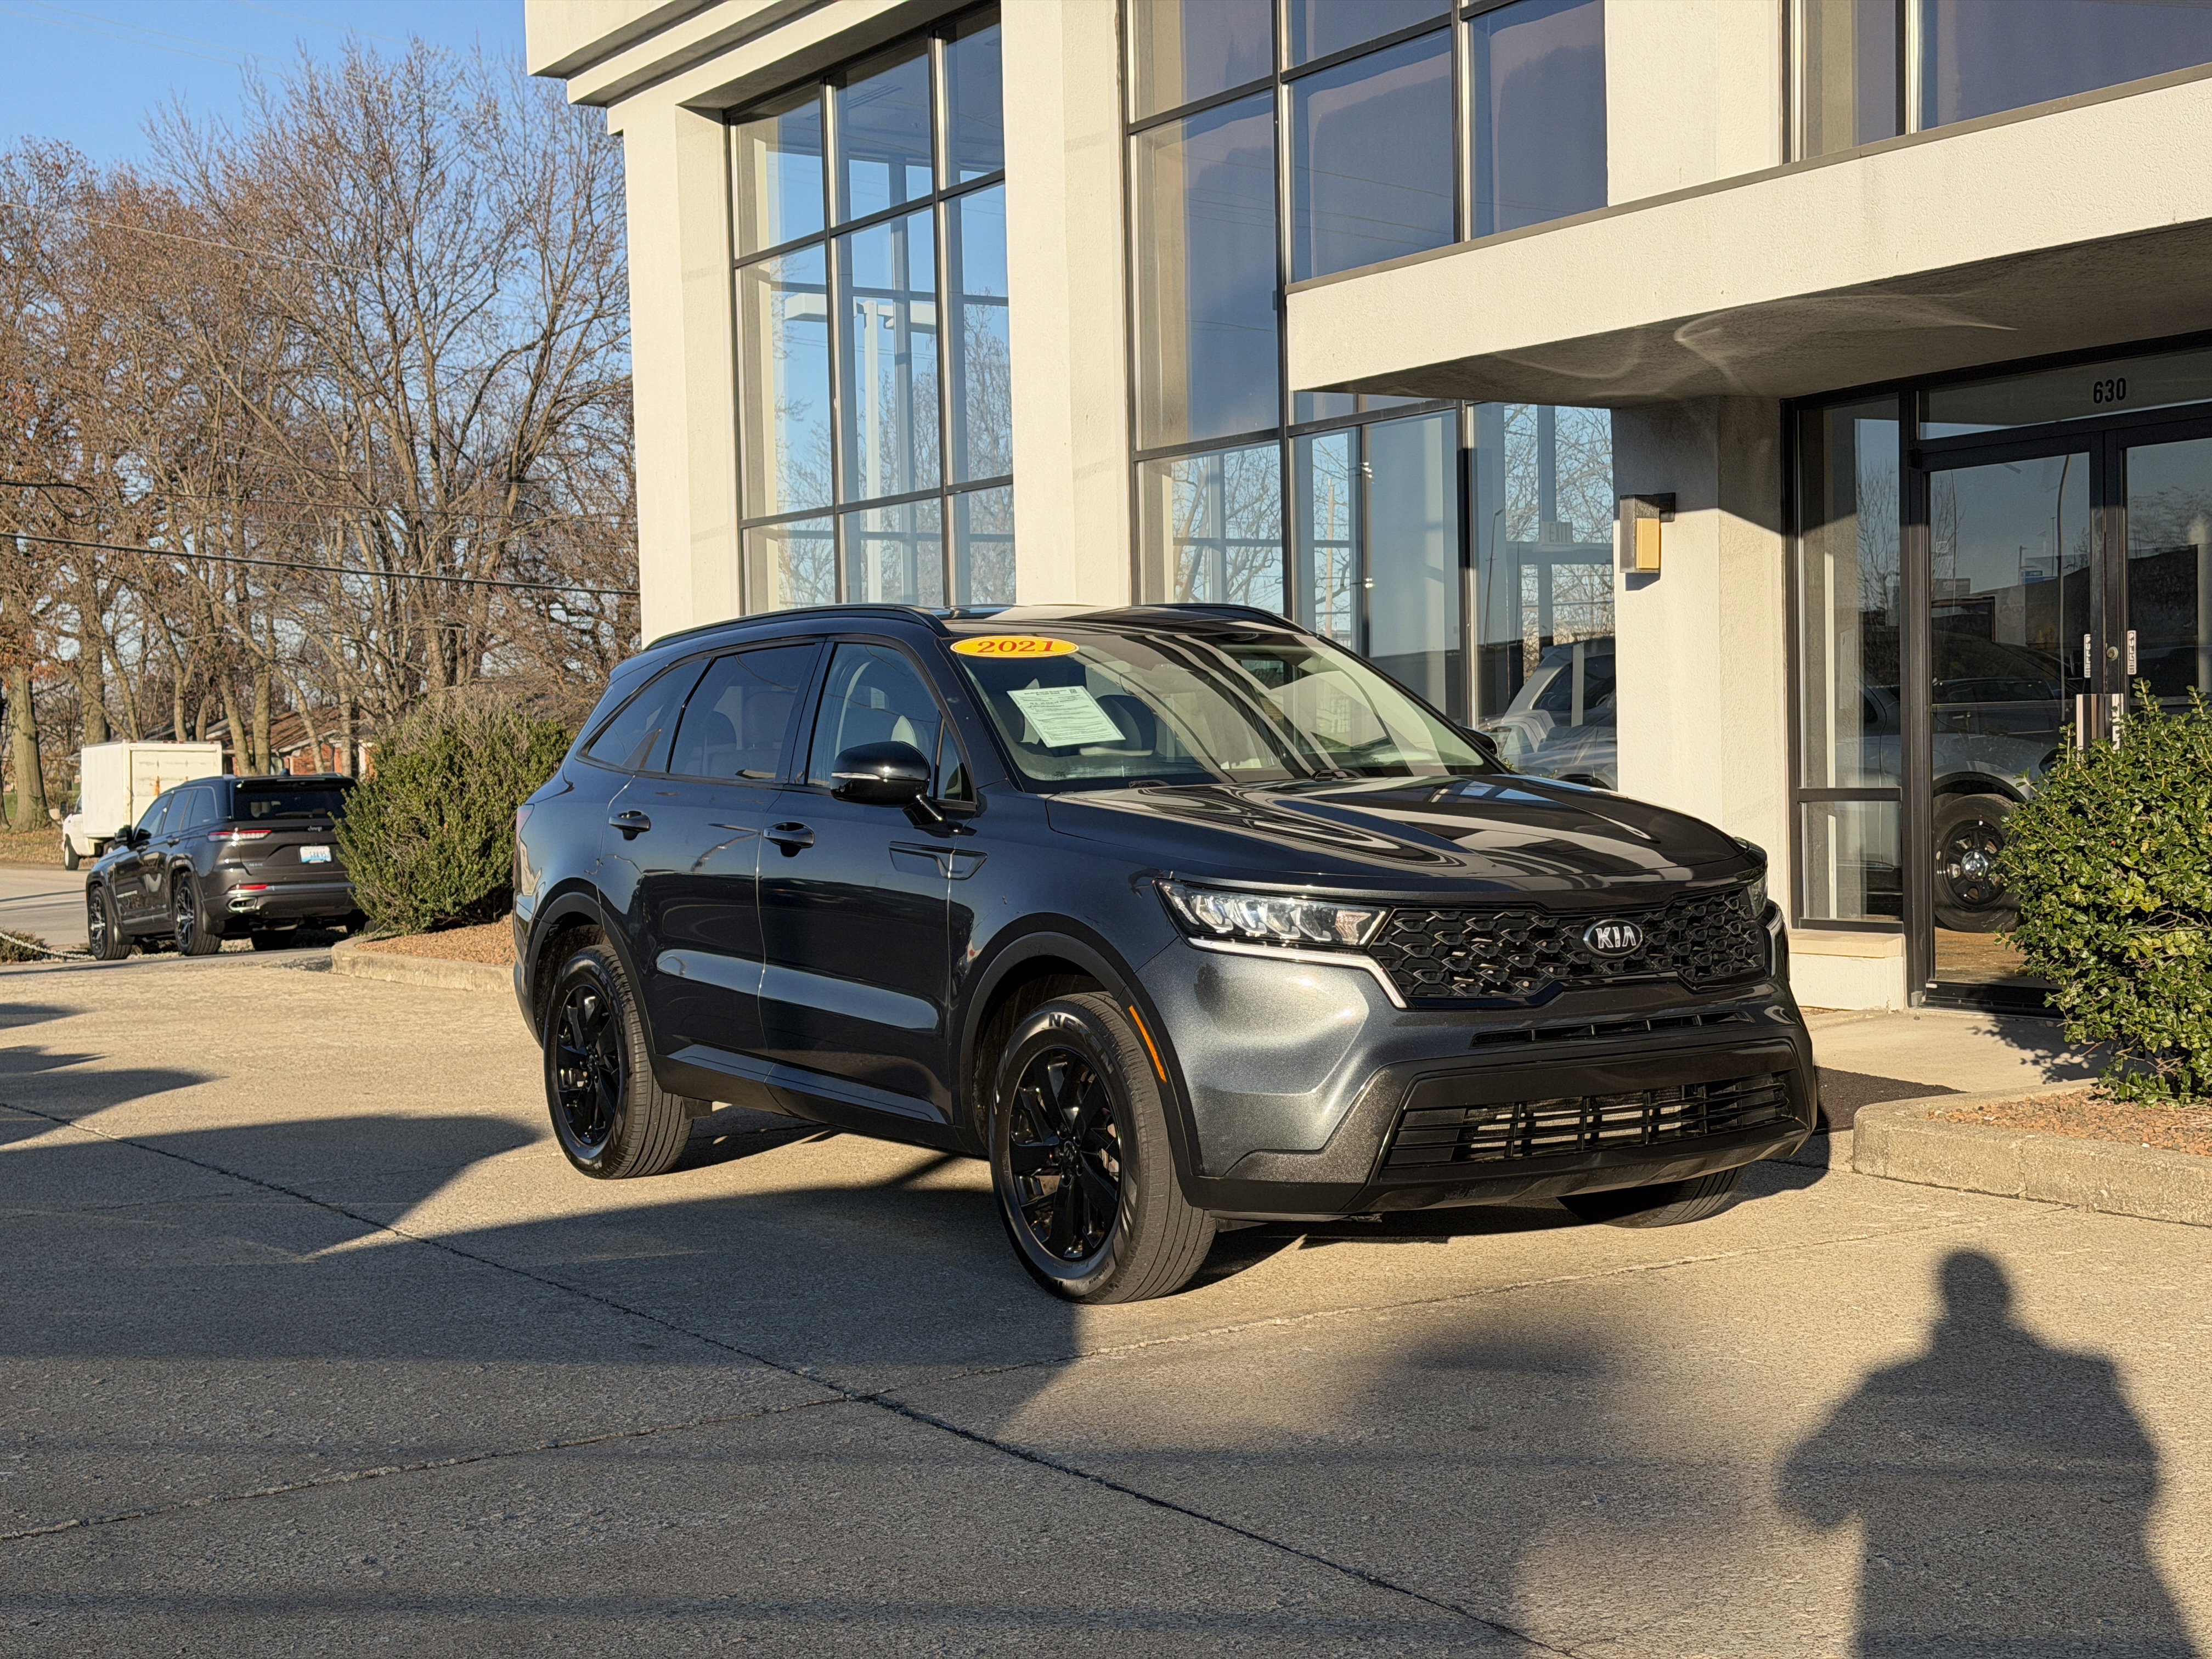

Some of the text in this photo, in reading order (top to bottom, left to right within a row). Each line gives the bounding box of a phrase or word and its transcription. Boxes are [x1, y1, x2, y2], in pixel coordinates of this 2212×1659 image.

[2093, 377, 2126, 404] 630
[1549, 522, 1570, 543] EXIT
[977, 640, 1054, 653] 2021
[1595, 926, 1637, 949] KIA
